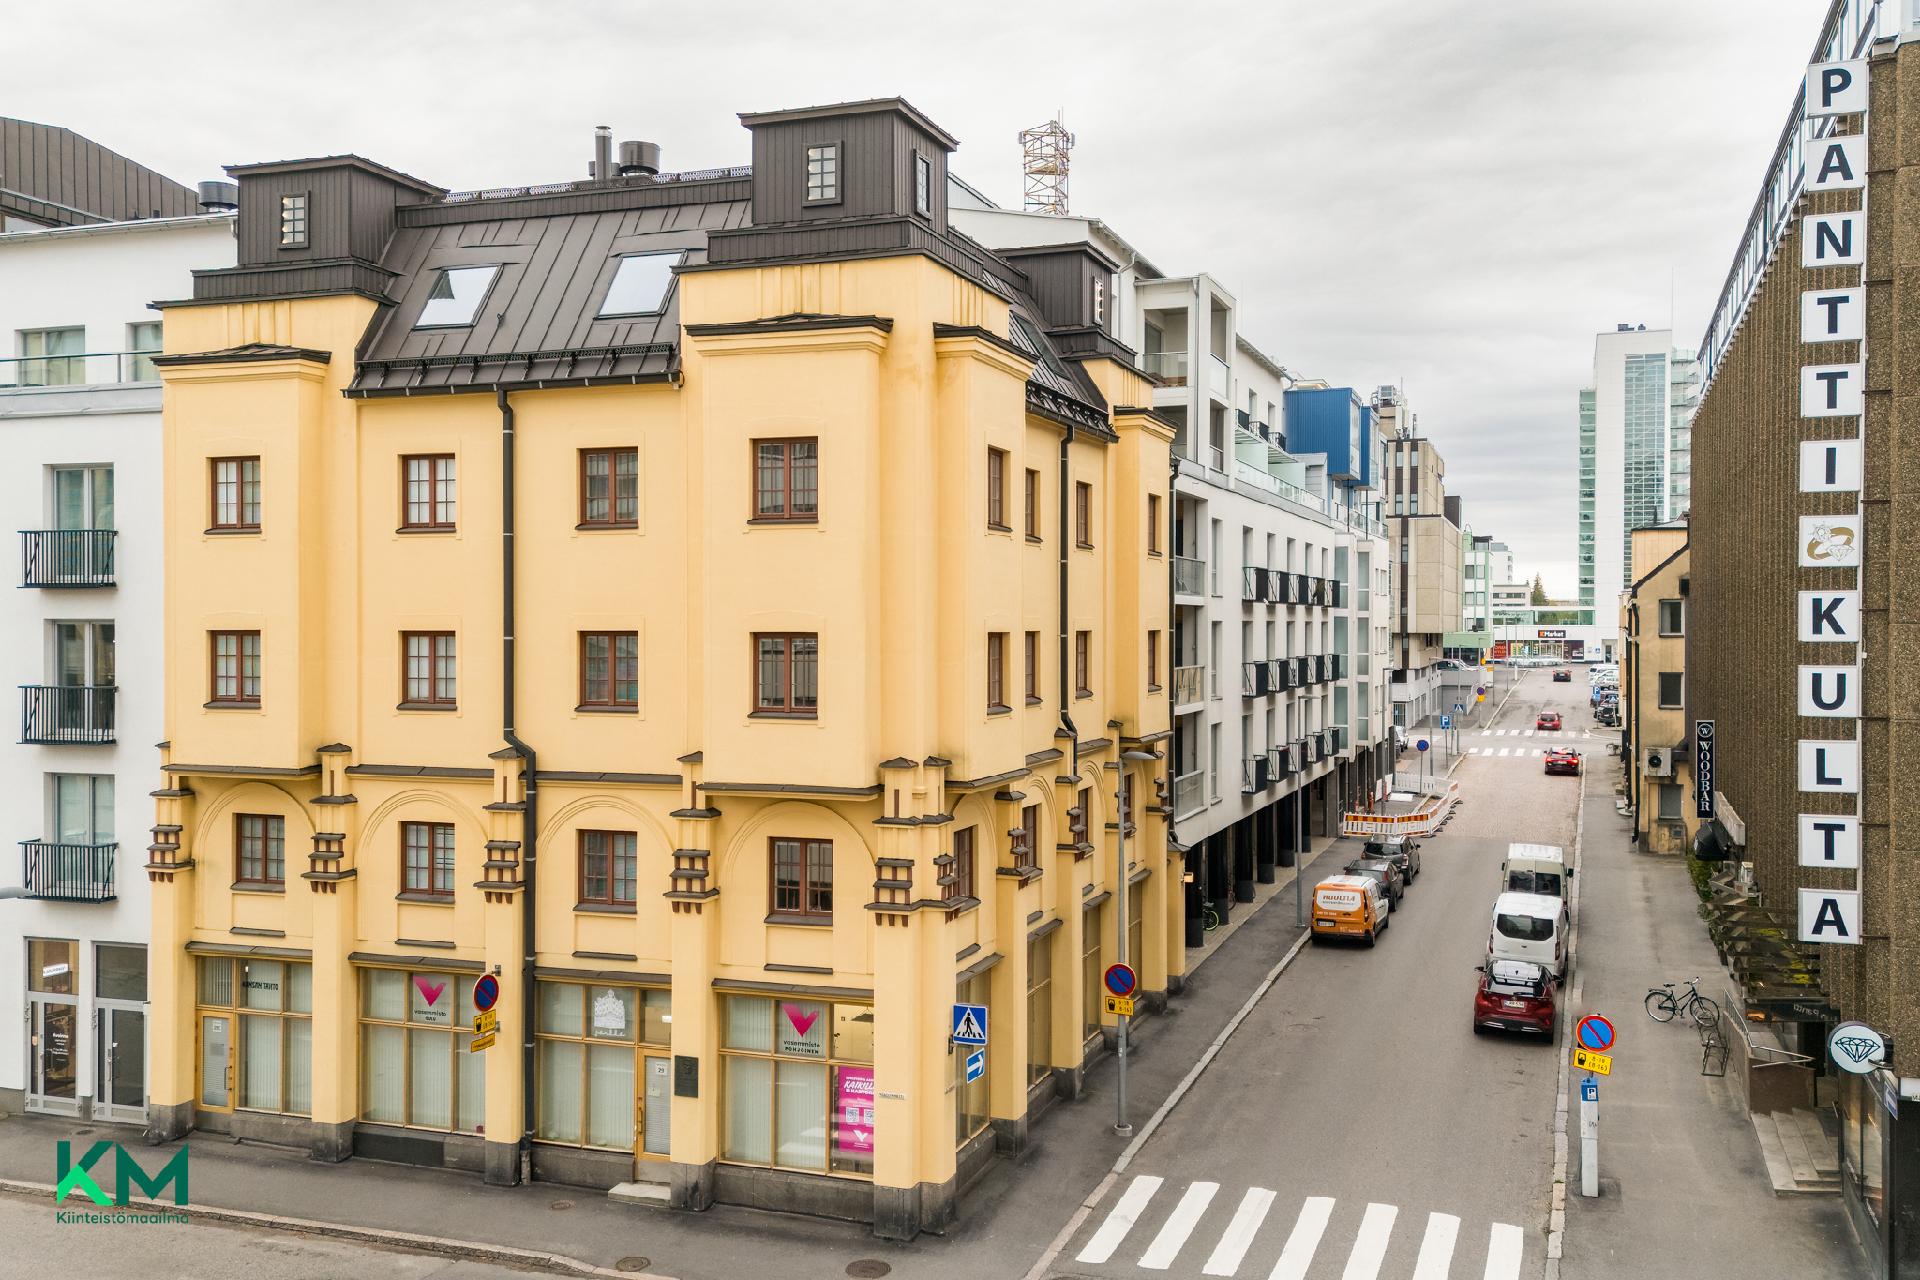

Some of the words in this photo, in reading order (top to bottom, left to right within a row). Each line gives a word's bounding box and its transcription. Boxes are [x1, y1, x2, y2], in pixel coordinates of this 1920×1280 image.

[1815, 68, 1854, 486] PANTTI
[1699, 741, 1712, 811] WOODBAR
[1811, 597, 1850, 938] KULTA
[783, 1040, 820, 1048] vasemmisto
[843, 1080, 874, 1090] KAIKILL
